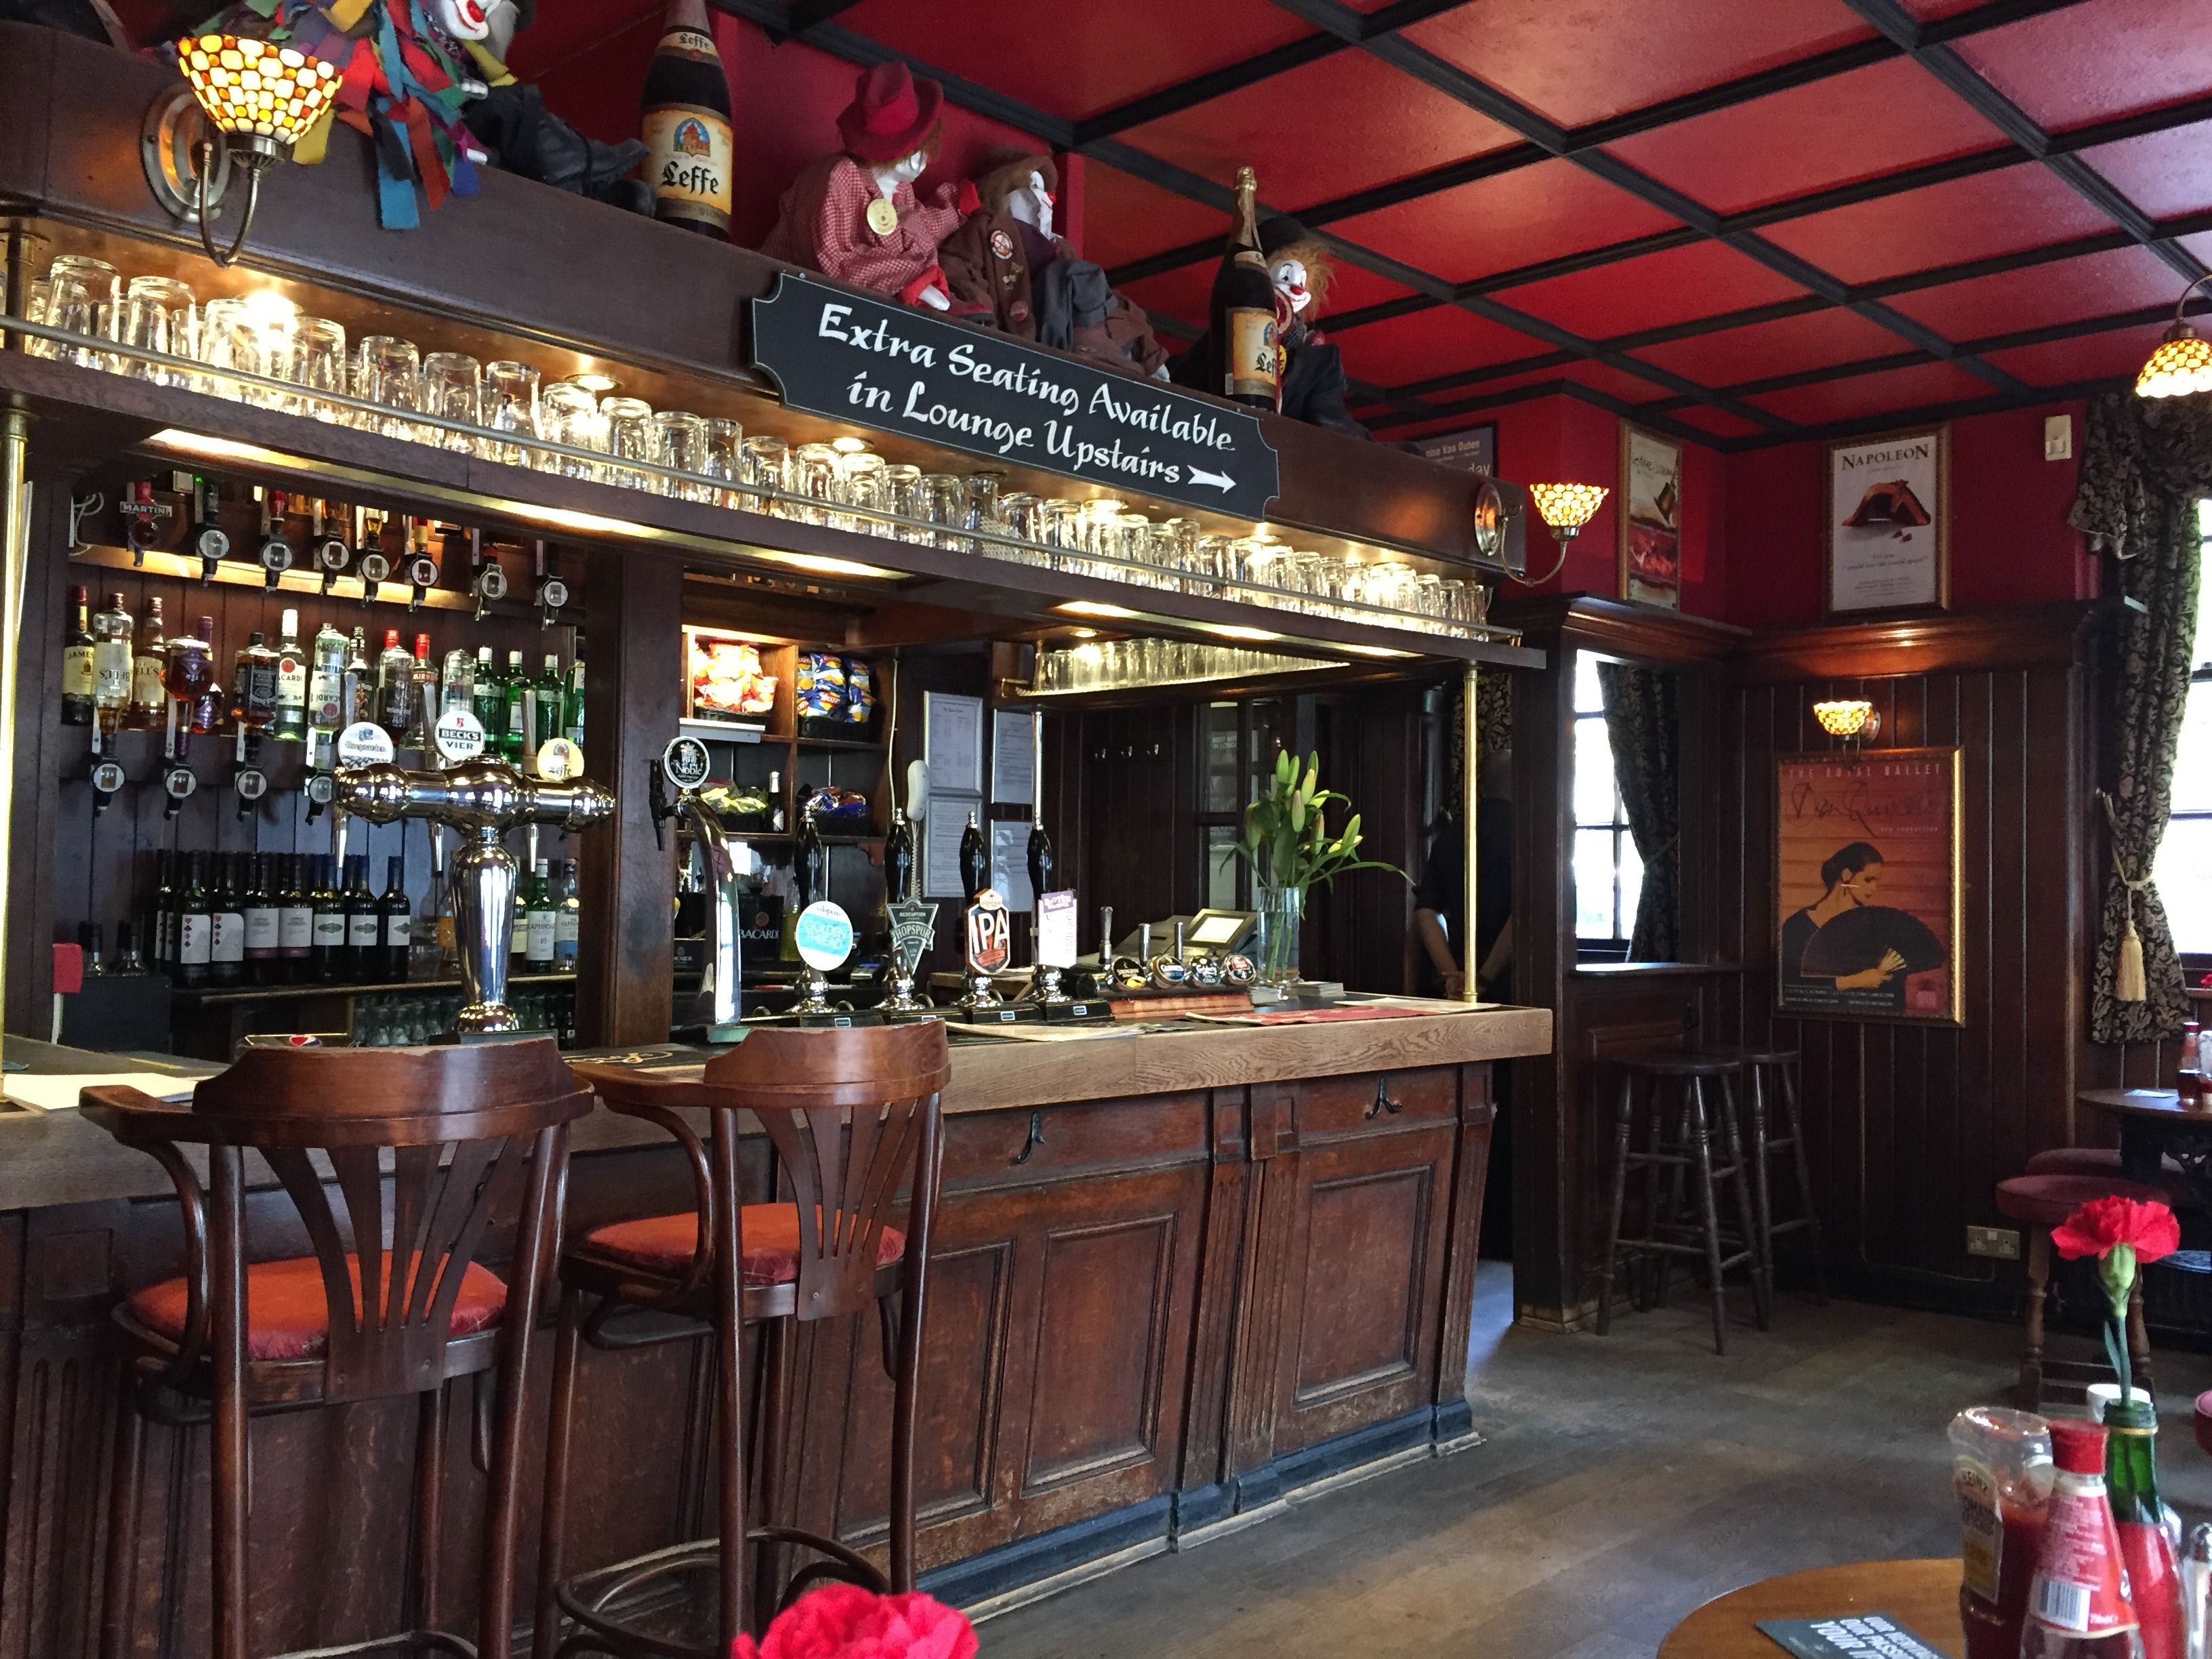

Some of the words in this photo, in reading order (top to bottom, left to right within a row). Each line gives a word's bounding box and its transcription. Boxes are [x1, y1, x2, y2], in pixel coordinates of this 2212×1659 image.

[678, 33, 710, 51] Leffe
[661, 161, 719, 197] Leffe
[1257, 352, 1279, 379] Lef
[818, 303, 937, 368] Extra
[948, 344, 1079, 417] Seating
[1088, 383, 1235, 451] Available
[846, 371, 894, 412] in
[902, 380, 1035, 454] Lounge
[1044, 420, 1181, 483] Upstairs
[1425, 447, 1441, 457] nise
[122, 504, 172, 515] MARTINI
[135, 666, 160, 676] ELL'S
[446, 741, 474, 750] VIER
[675, 763, 703, 775] Noble
[1789, 769, 1814, 779] THE
[1885, 764, 1940, 776] BALLET
[895, 924, 932, 941] HOPSPUR
[968, 908, 1008, 954] IPA
